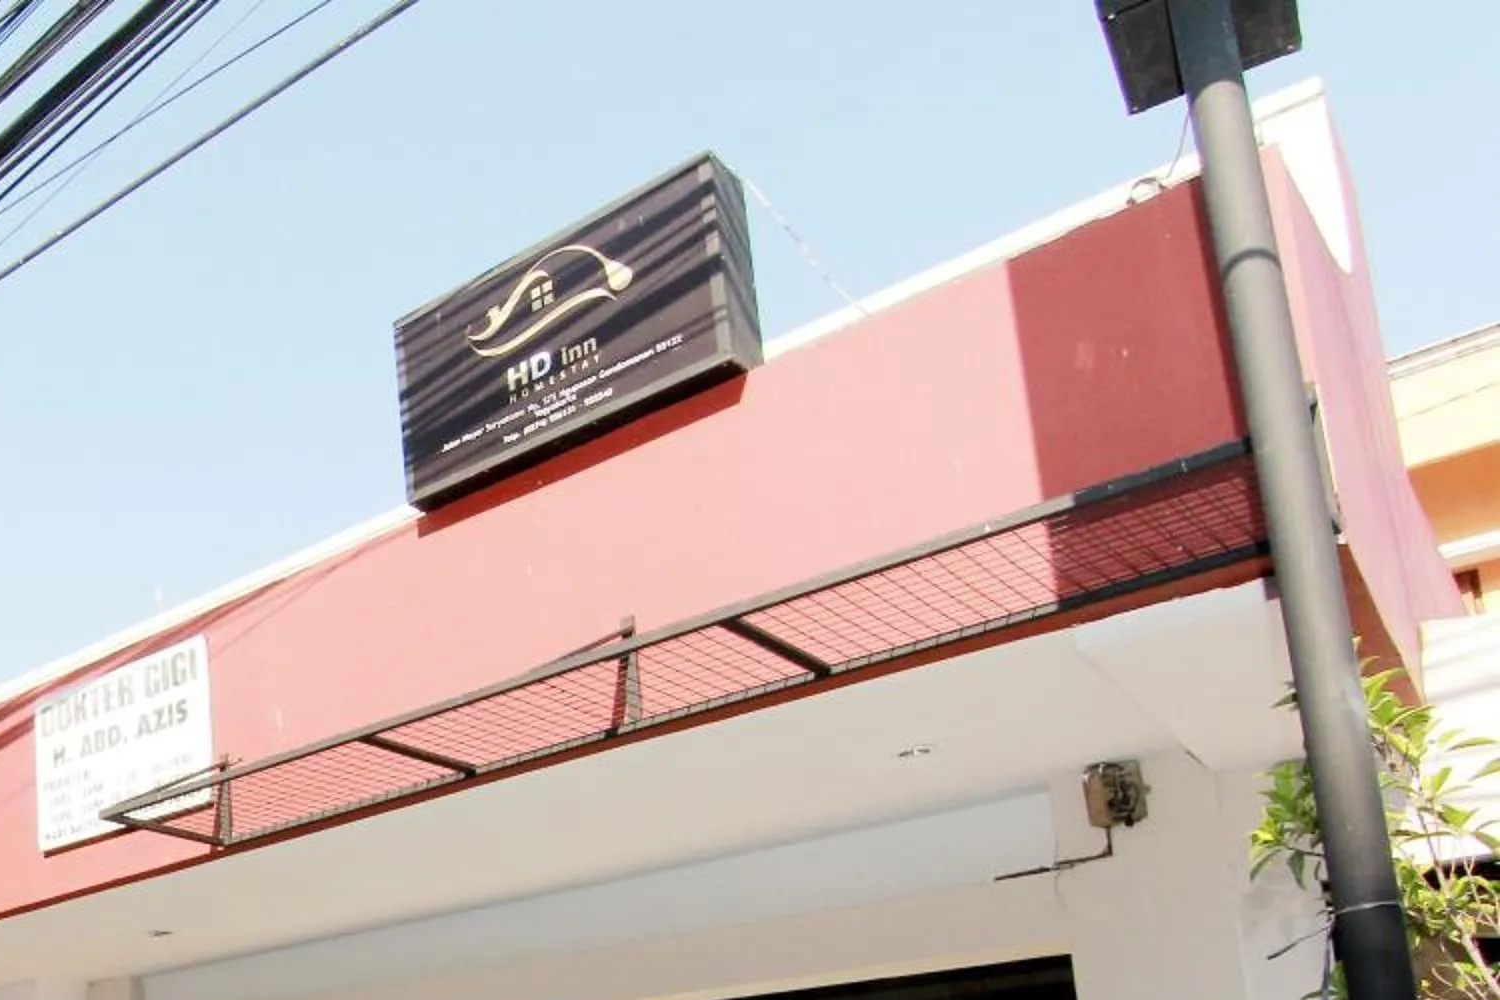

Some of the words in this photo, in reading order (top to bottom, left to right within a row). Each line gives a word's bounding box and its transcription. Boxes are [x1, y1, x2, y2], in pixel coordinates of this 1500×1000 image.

[506, 351, 553, 391] HD
[509, 355, 600, 404] HOMESTAY
[39, 673, 135, 737] DOKTER
[144, 647, 199, 698] GIGI
[135, 698, 189, 737] AZIS
